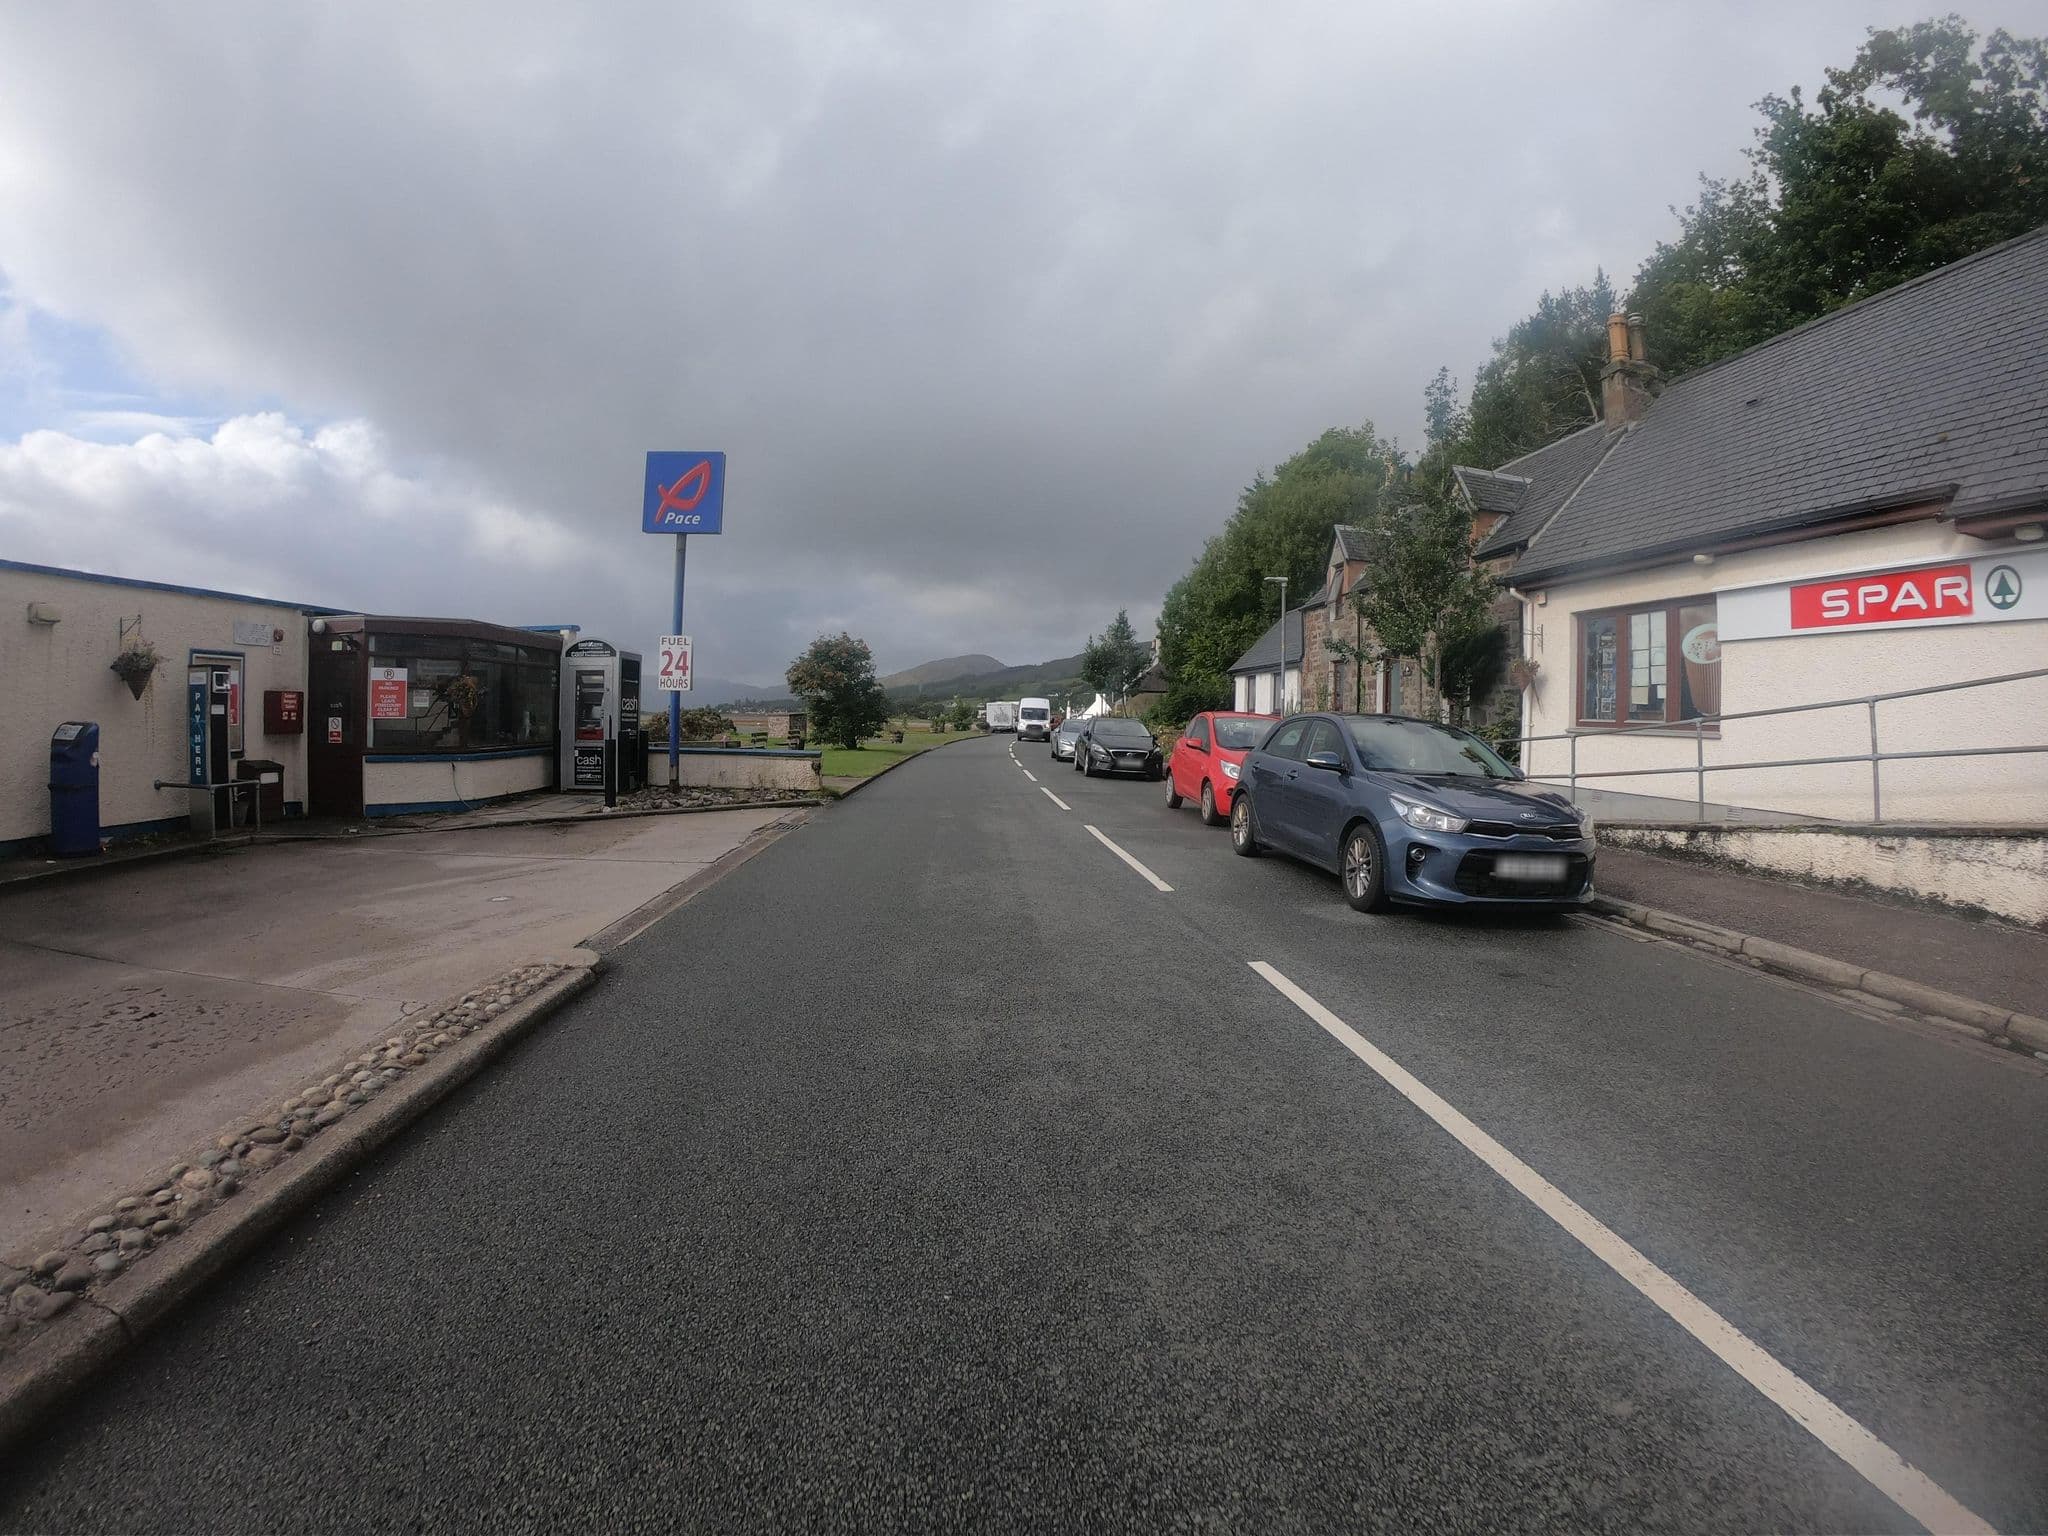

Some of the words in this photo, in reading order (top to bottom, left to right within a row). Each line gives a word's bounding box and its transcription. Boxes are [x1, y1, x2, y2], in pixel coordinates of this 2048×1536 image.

[665, 512, 701, 525] Pace
[1821, 575, 1969, 619] SPAR
[661, 637, 690, 646] FUEL
[660, 650, 689, 677] 24
[660, 678, 689, 689] HOURS
[194, 692, 202, 723] PAY
[621, 695, 638, 711] cash
[194, 734, 203, 776] HERE
[576, 754, 602, 766] cash
